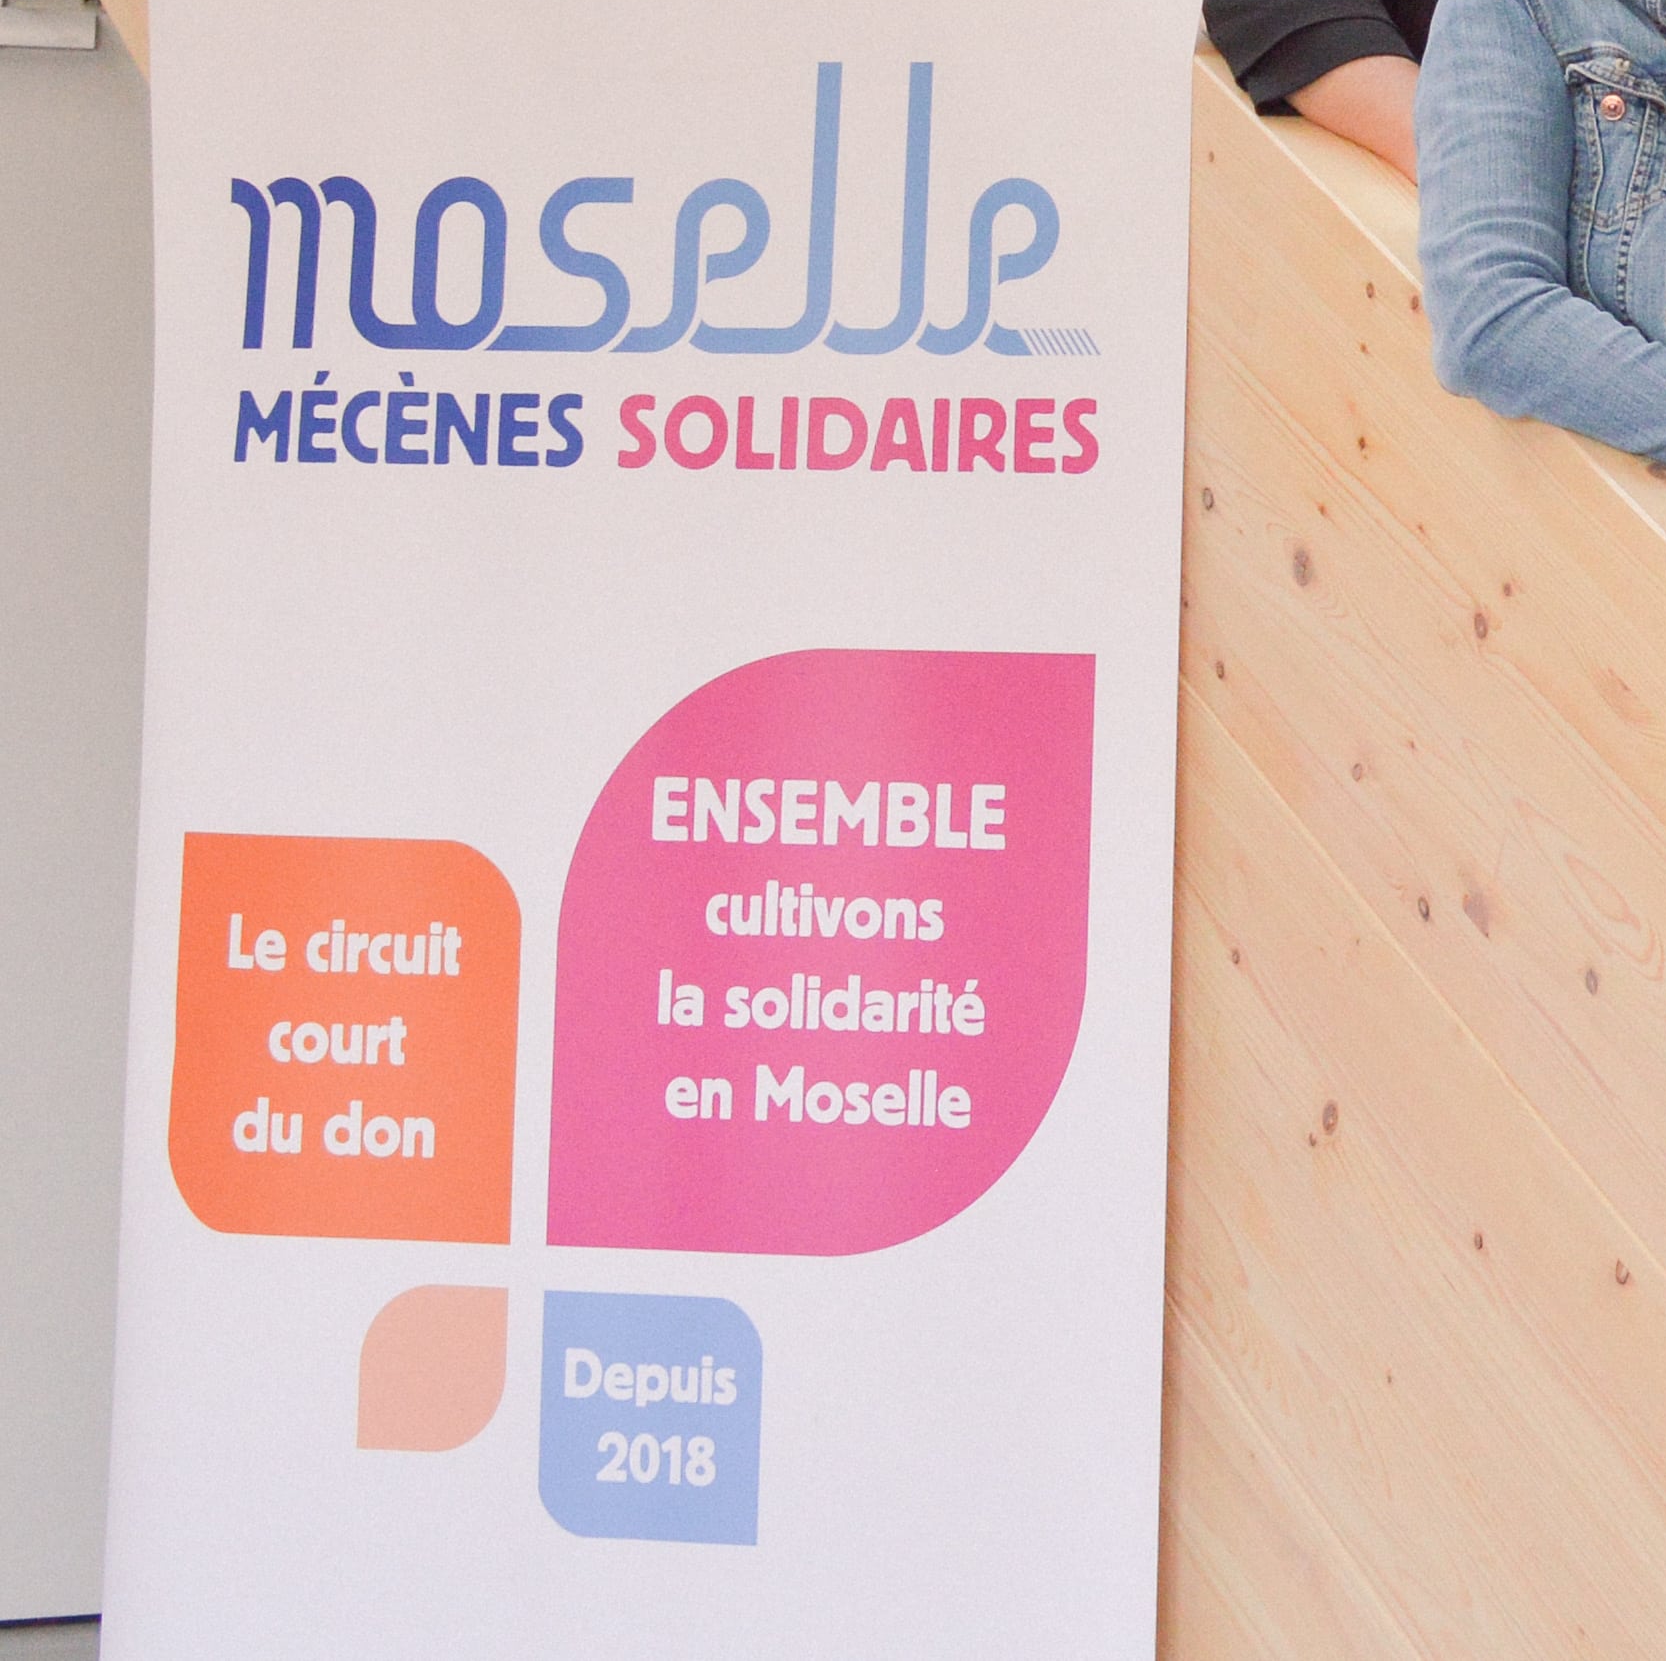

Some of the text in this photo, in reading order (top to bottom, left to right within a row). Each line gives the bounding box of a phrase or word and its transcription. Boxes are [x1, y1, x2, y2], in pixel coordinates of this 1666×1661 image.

[231, 61, 1066, 356] moselle
[233, 371, 1100, 475] MÉCÈNES SOLIDAIRES
[650, 775, 1008, 851] ENSEMBLE
[704, 879, 946, 942] cultivons
[226, 912, 463, 977] Le circuit
[656, 969, 987, 1037] la solidarité
[267, 1015, 409, 1067] court
[231, 1096, 437, 1159] du don
[664, 1064, 973, 1129] en Moselle
[562, 1347, 739, 1408] Depuis
[595, 1430, 717, 1487] 2018
